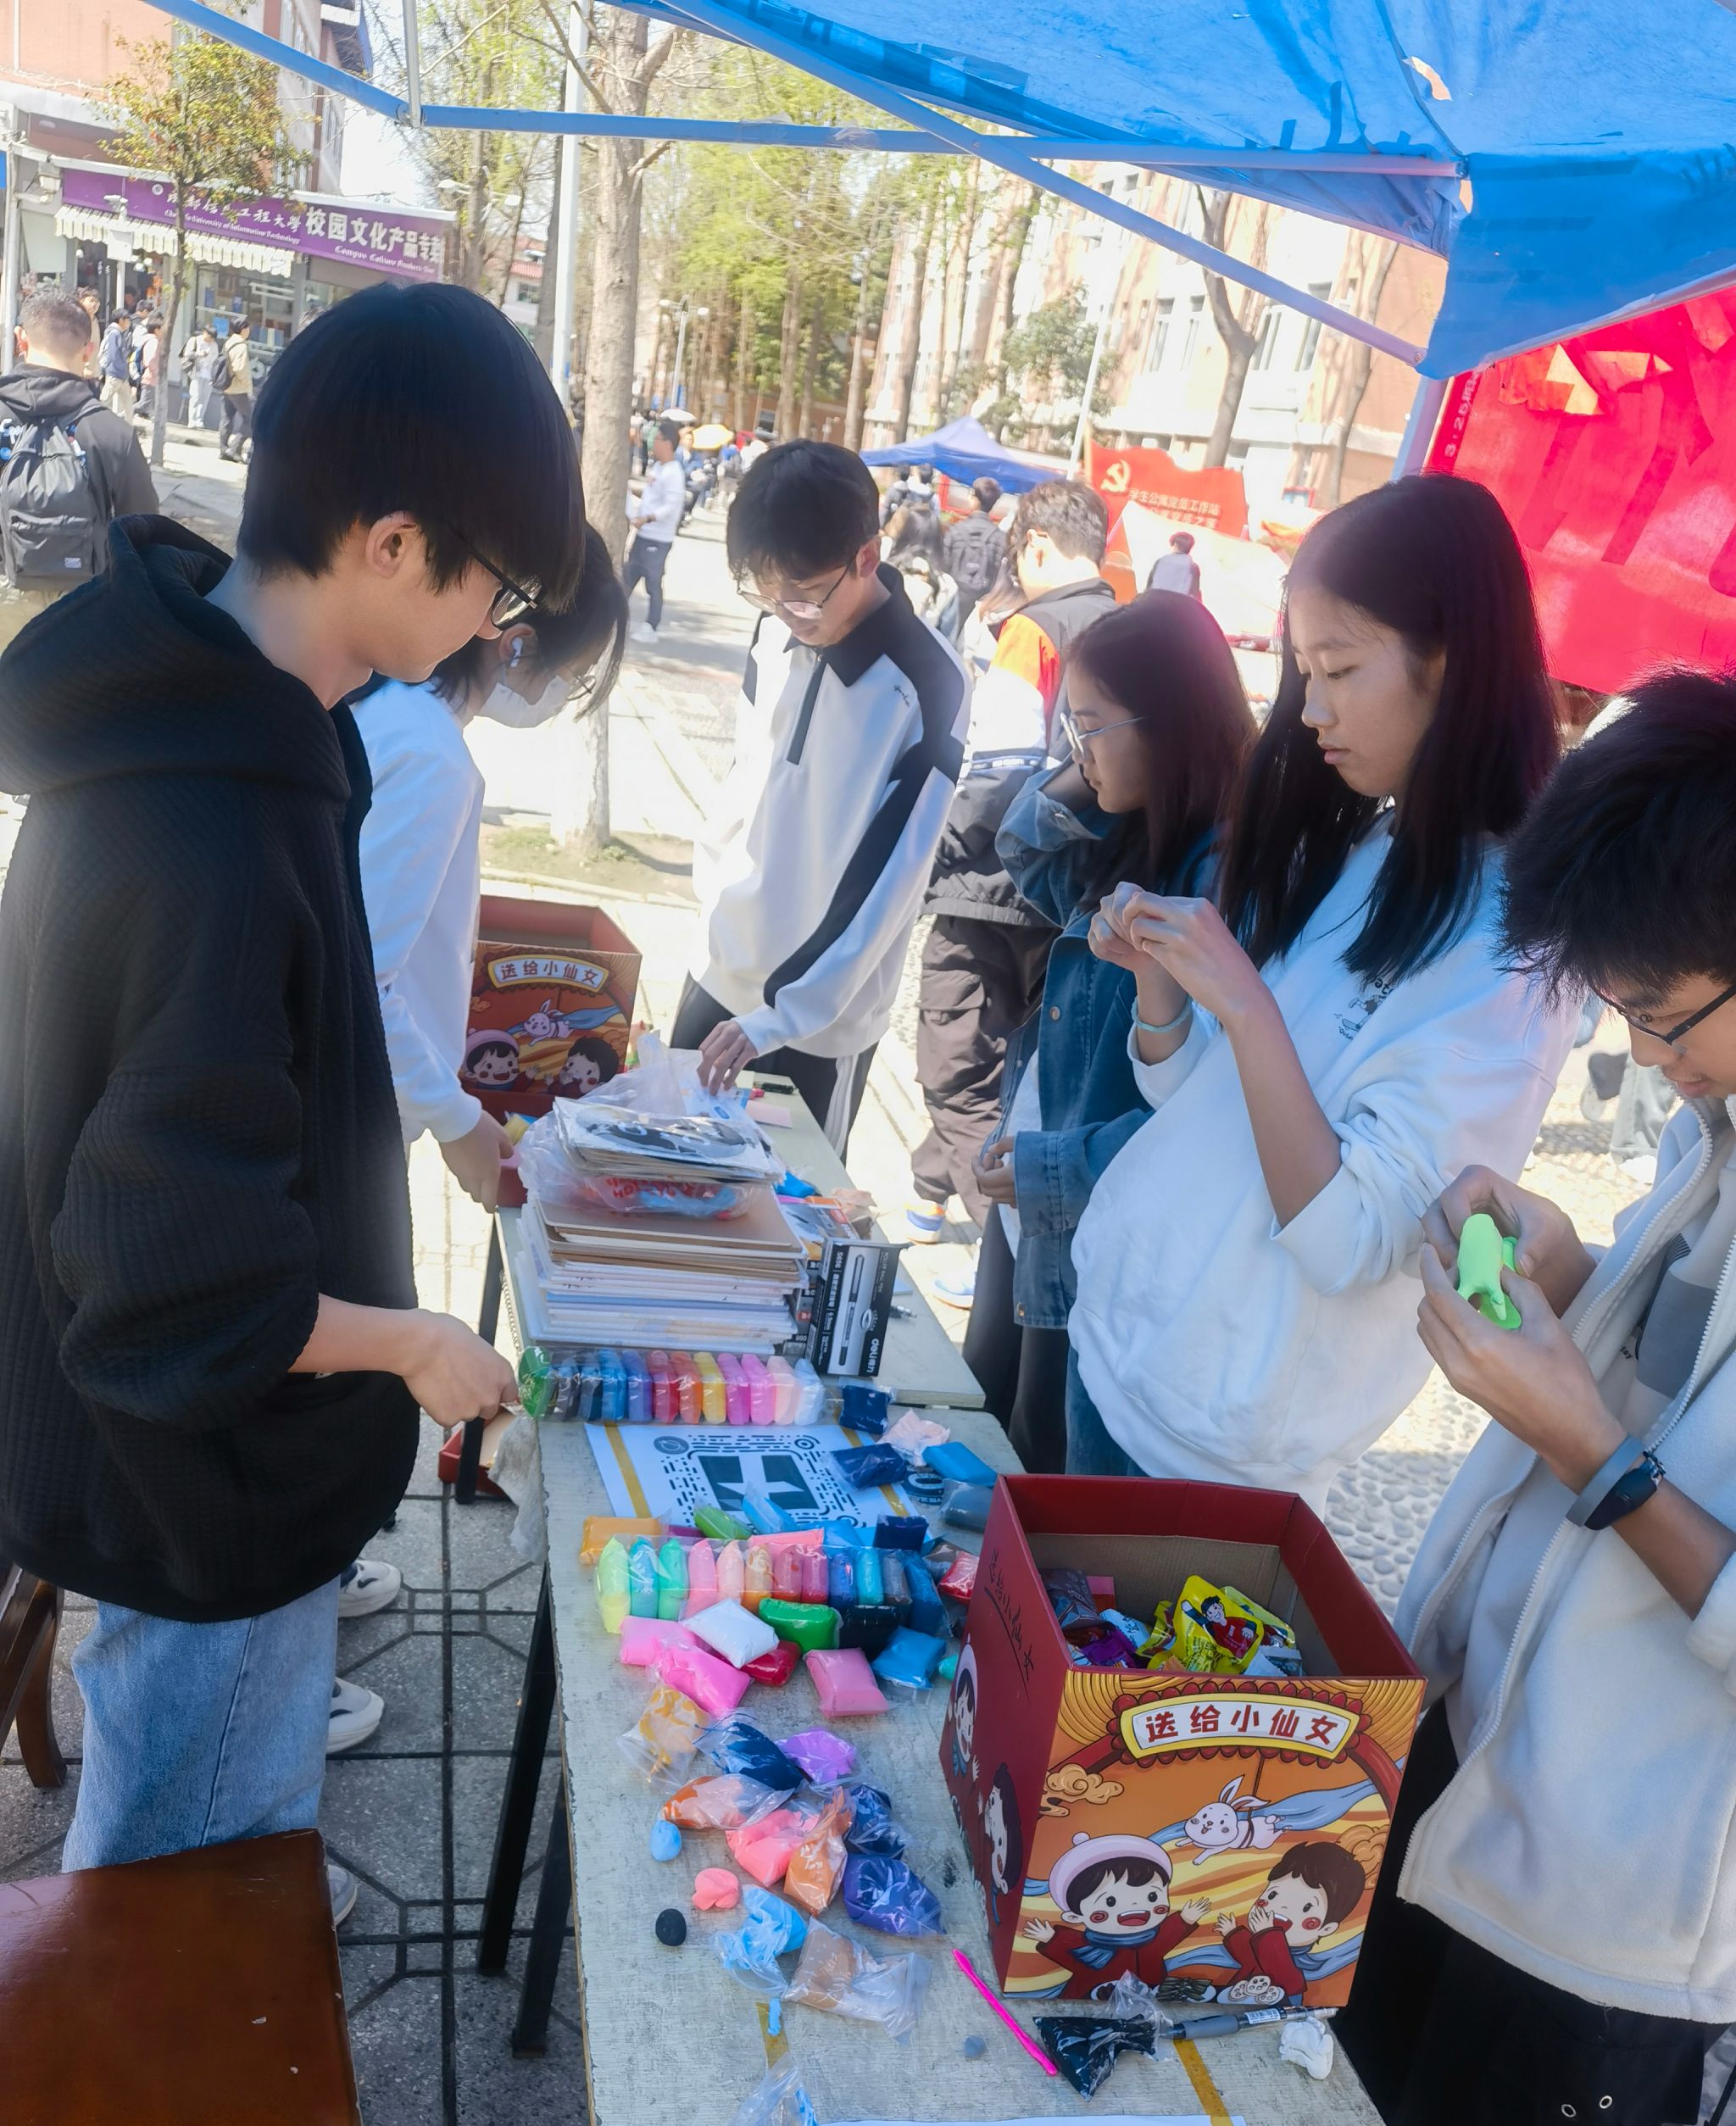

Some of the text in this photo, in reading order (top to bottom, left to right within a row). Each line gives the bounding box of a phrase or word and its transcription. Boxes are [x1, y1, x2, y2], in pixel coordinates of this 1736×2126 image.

[335, 245, 367, 259] Campus
[500, 960, 598, 985] 送给小仙女
[1145, 1703, 1338, 1745] 送给小仙女
